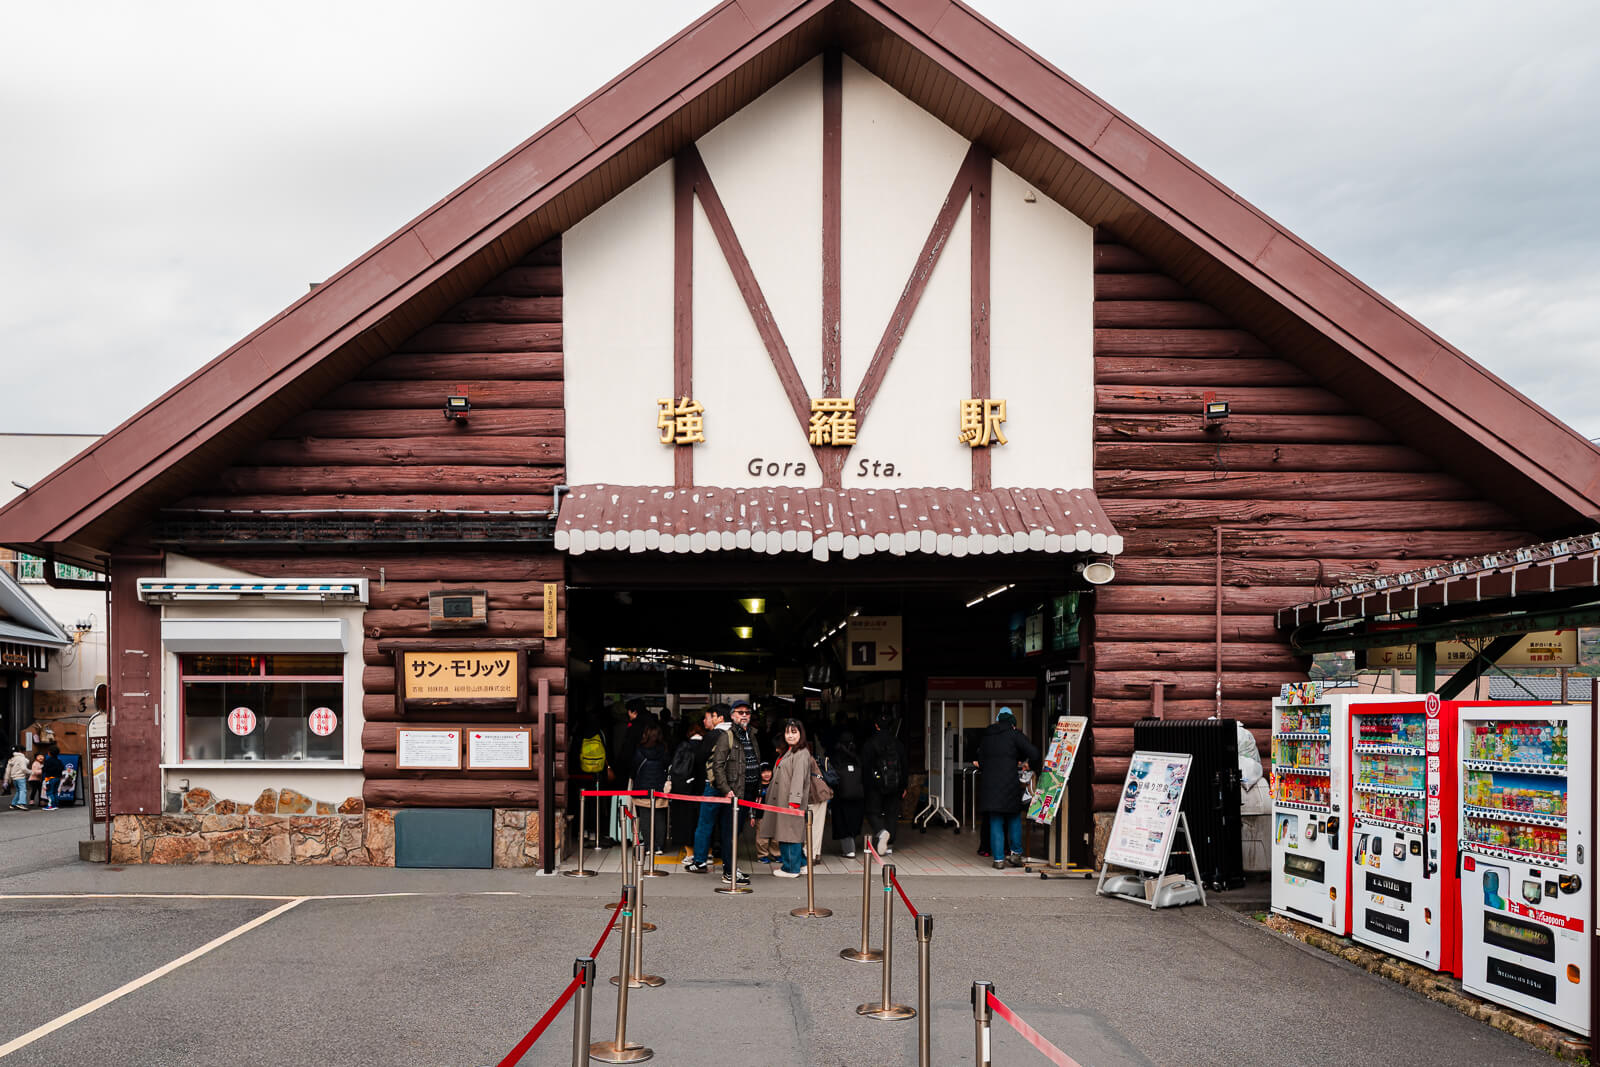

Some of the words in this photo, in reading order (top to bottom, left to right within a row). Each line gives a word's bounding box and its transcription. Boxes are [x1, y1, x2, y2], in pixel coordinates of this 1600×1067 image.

[748, 458, 807, 477] Gora
[857, 458, 903, 477] Sta.
[1396, 651, 1412, 660] 出口
[411, 659, 511, 678] サン・モリッツ
